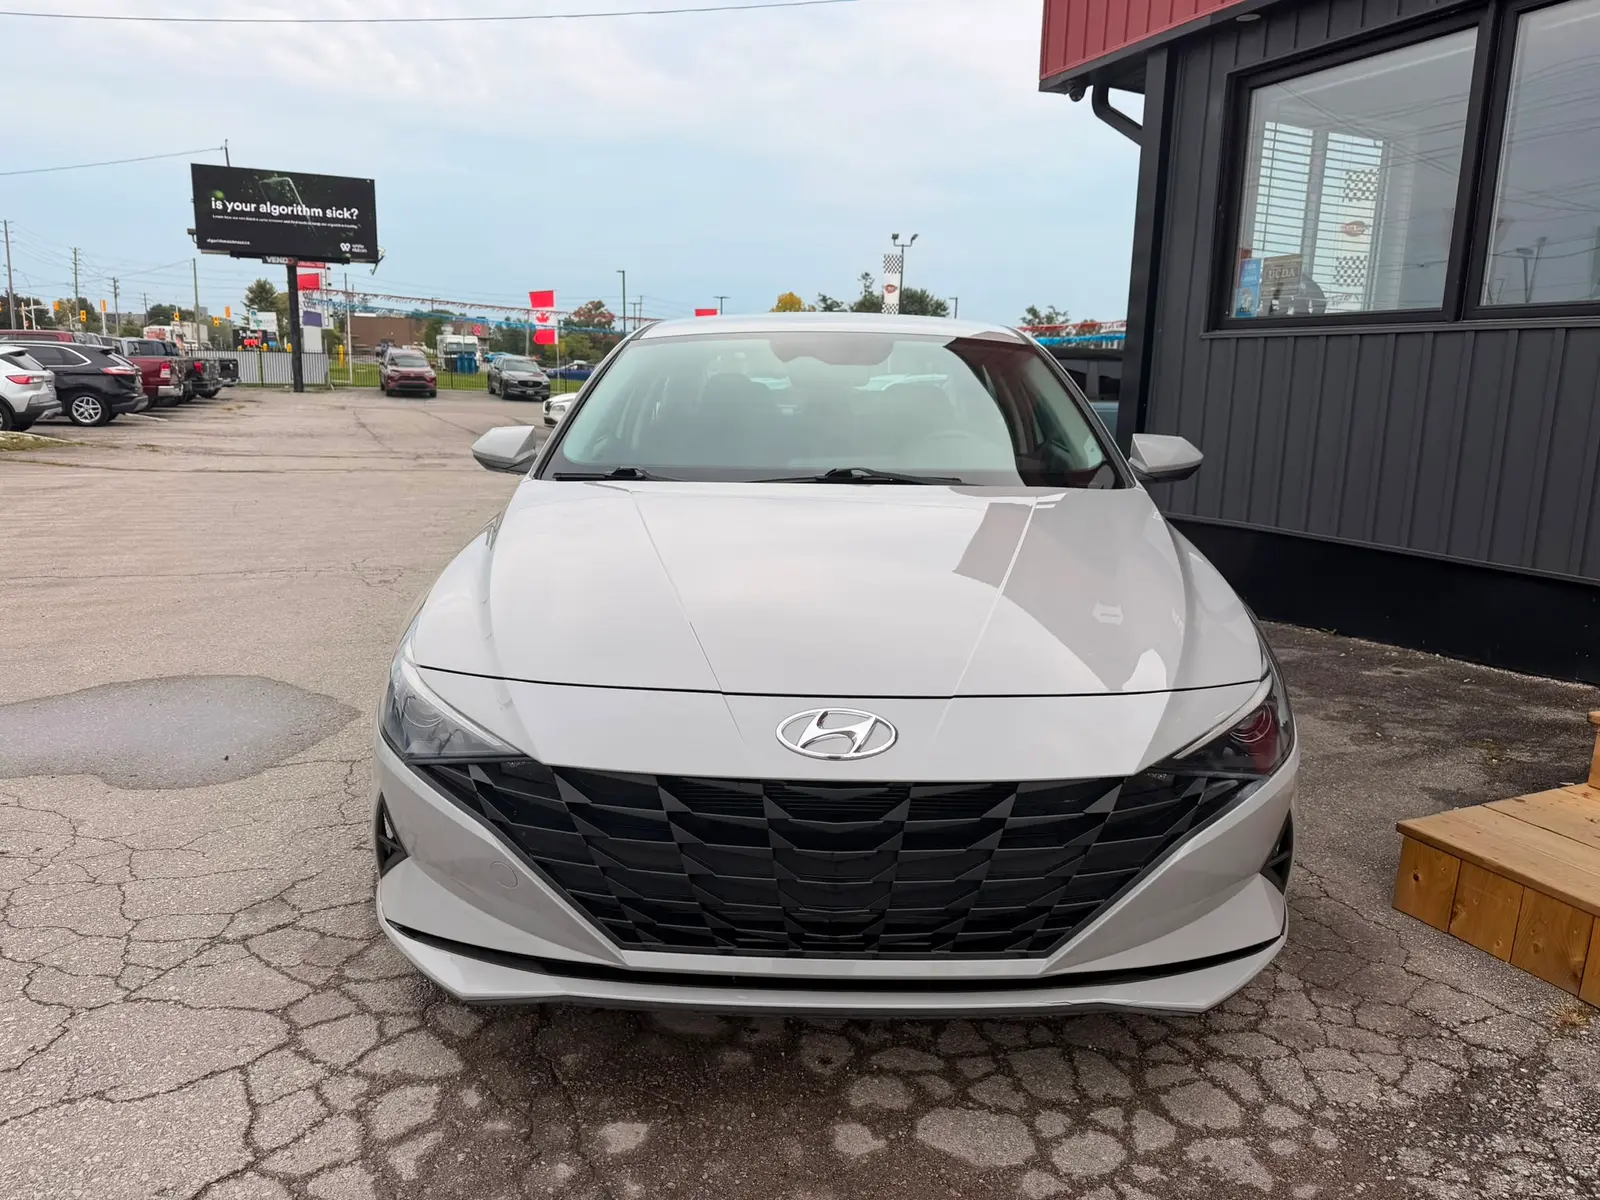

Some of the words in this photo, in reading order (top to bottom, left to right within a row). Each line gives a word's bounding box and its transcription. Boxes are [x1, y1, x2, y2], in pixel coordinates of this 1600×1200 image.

[211, 197, 223, 209] is
[223, 200, 257, 213] your
[259, 201, 323, 217] algorithm
[325, 206, 359, 220] sick?
[1268, 268, 1295, 279] UCDA
